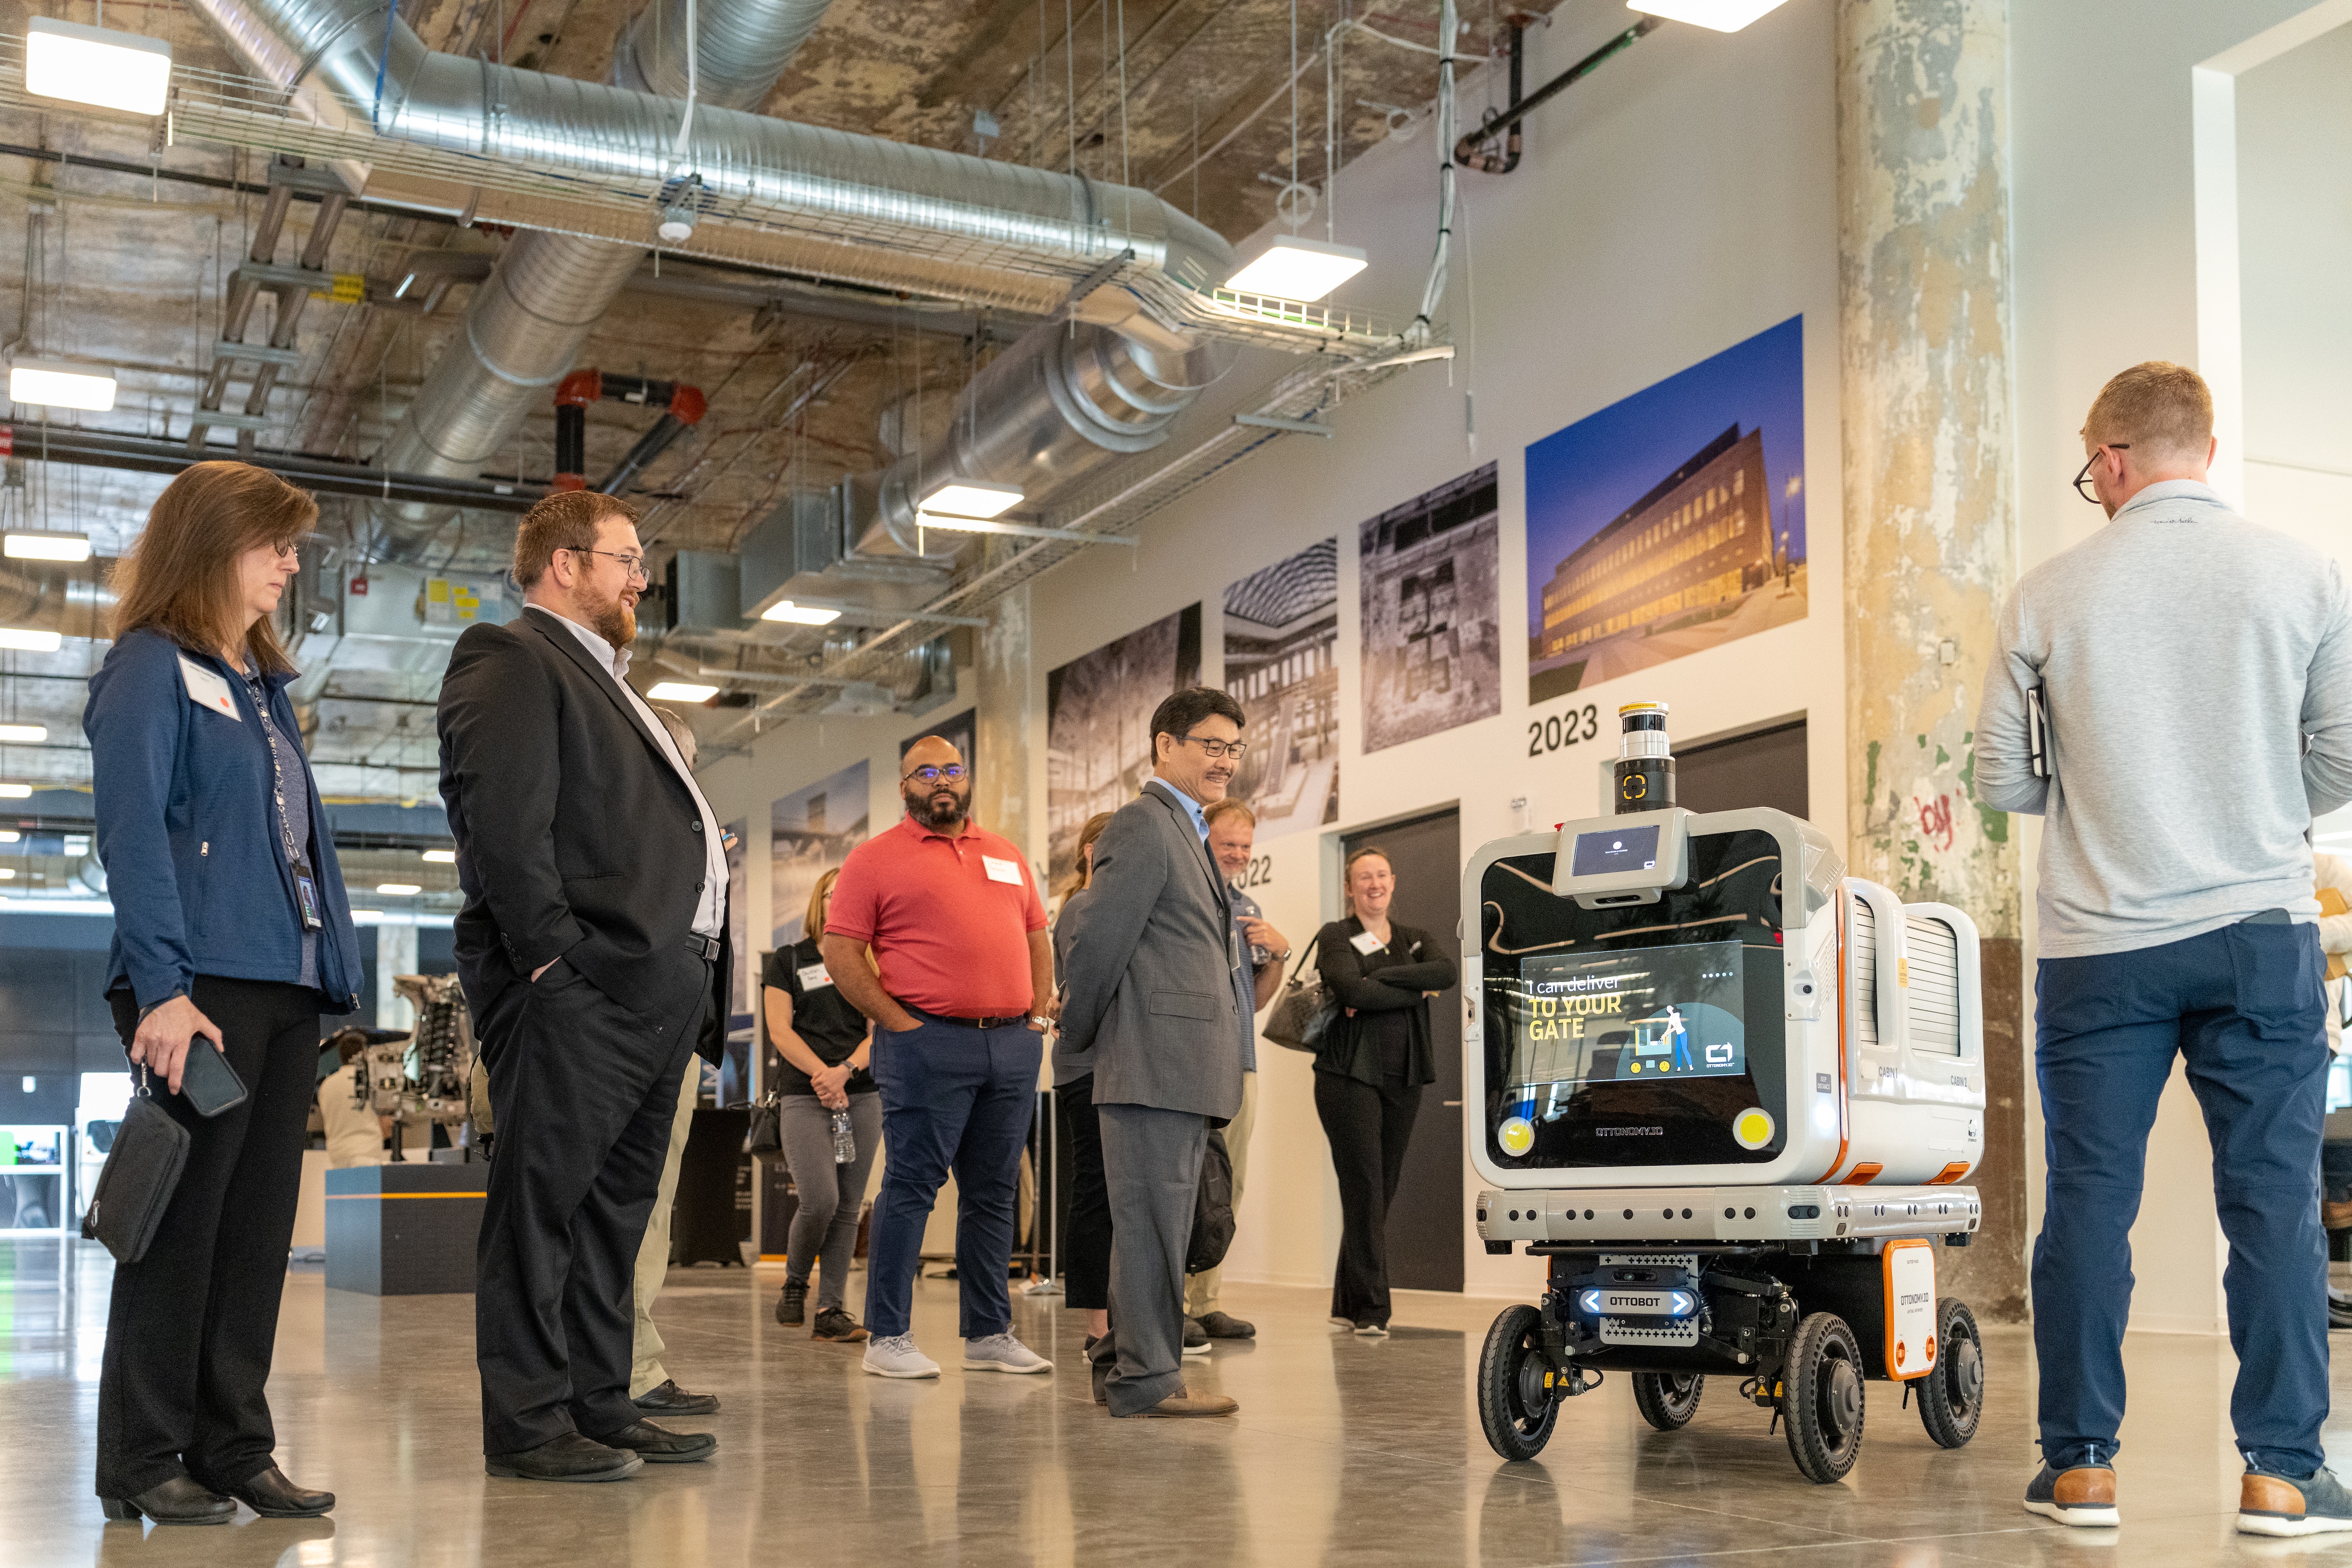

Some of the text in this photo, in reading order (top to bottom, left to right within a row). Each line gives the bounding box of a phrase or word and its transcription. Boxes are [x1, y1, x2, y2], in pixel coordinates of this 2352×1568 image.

[1529, 704, 1597, 757] 2023
[1236, 854, 1271, 889] 022
[1529, 975, 1621, 995] I can deliver
[1528, 994, 1622, 1018] TO YOUR
[1529, 1018, 1585, 1041] GATE
[1878, 1066, 1898, 1079] CABIN 1
[1950, 1075, 1967, 1087] CABIN 2
[1596, 1127, 1663, 1136] OTTONOMY.IO
[1610, 1297, 1660, 1306] OTTOBOT
[1901, 1292, 1929, 1305] OTTONOMY.IO
